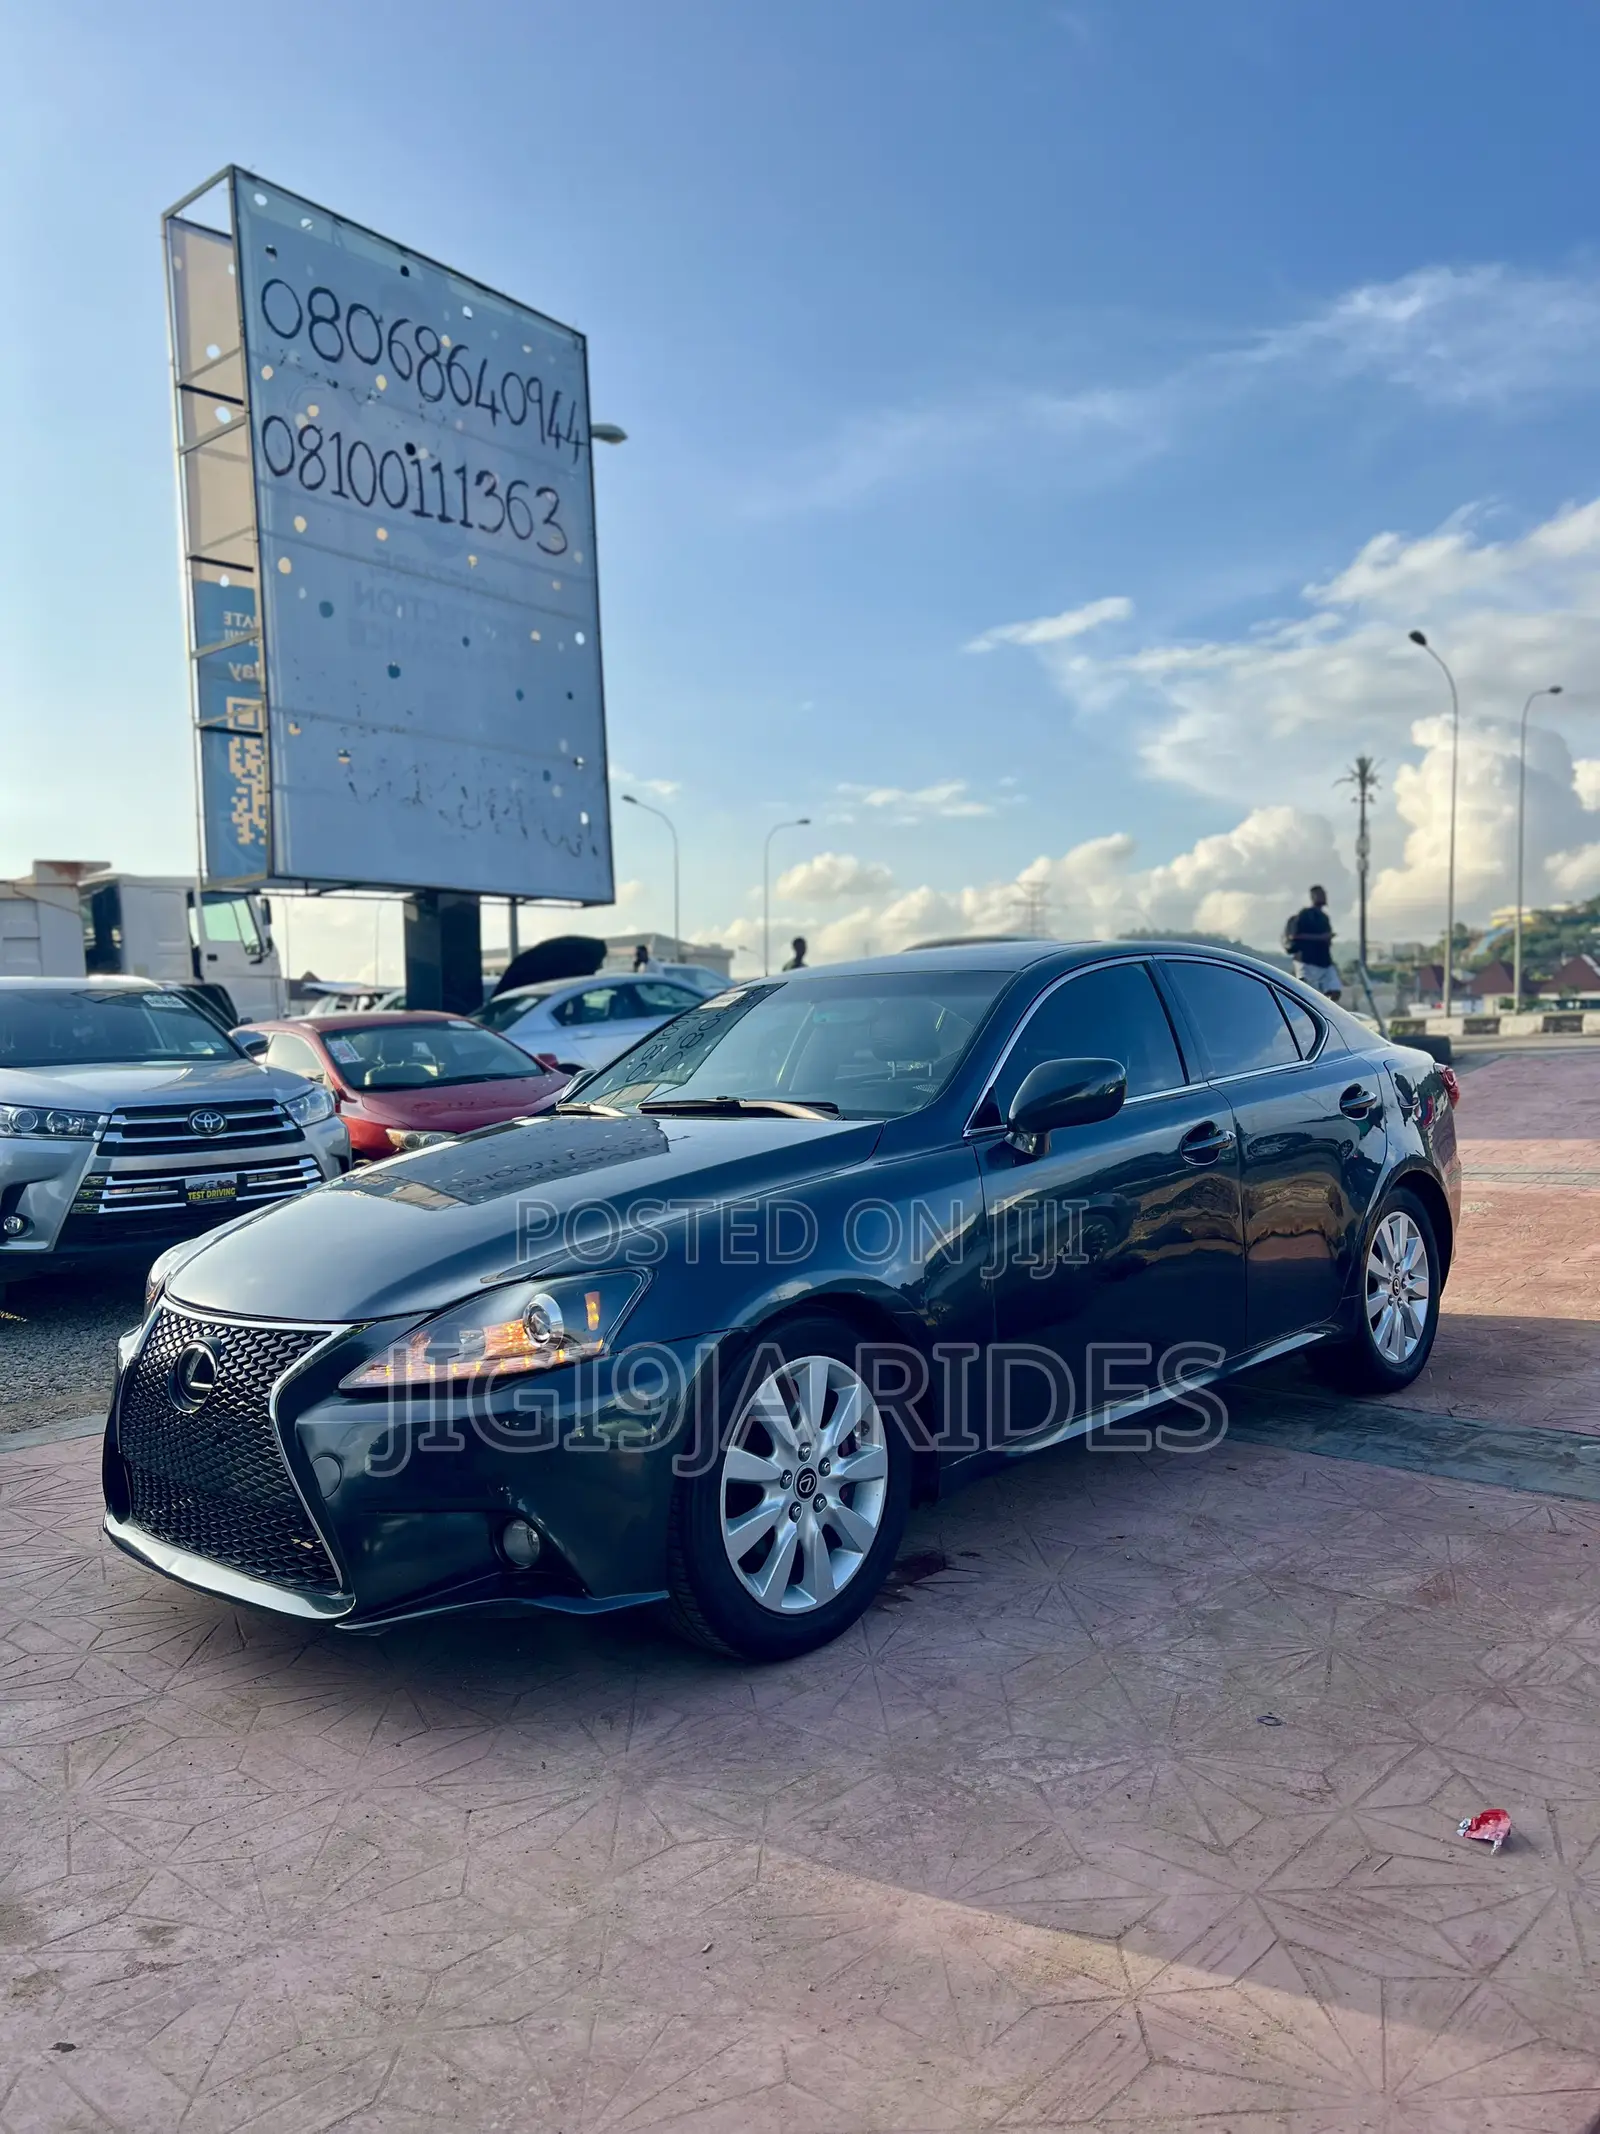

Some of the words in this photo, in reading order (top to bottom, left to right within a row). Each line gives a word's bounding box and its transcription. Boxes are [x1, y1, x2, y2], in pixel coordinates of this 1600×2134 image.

[261, 278, 589, 464] 08068640944
[261, 415, 568, 555] 08100111363
[187, 1190, 205, 1200] TEST
[206, 1187, 236, 1198] DRIVING
